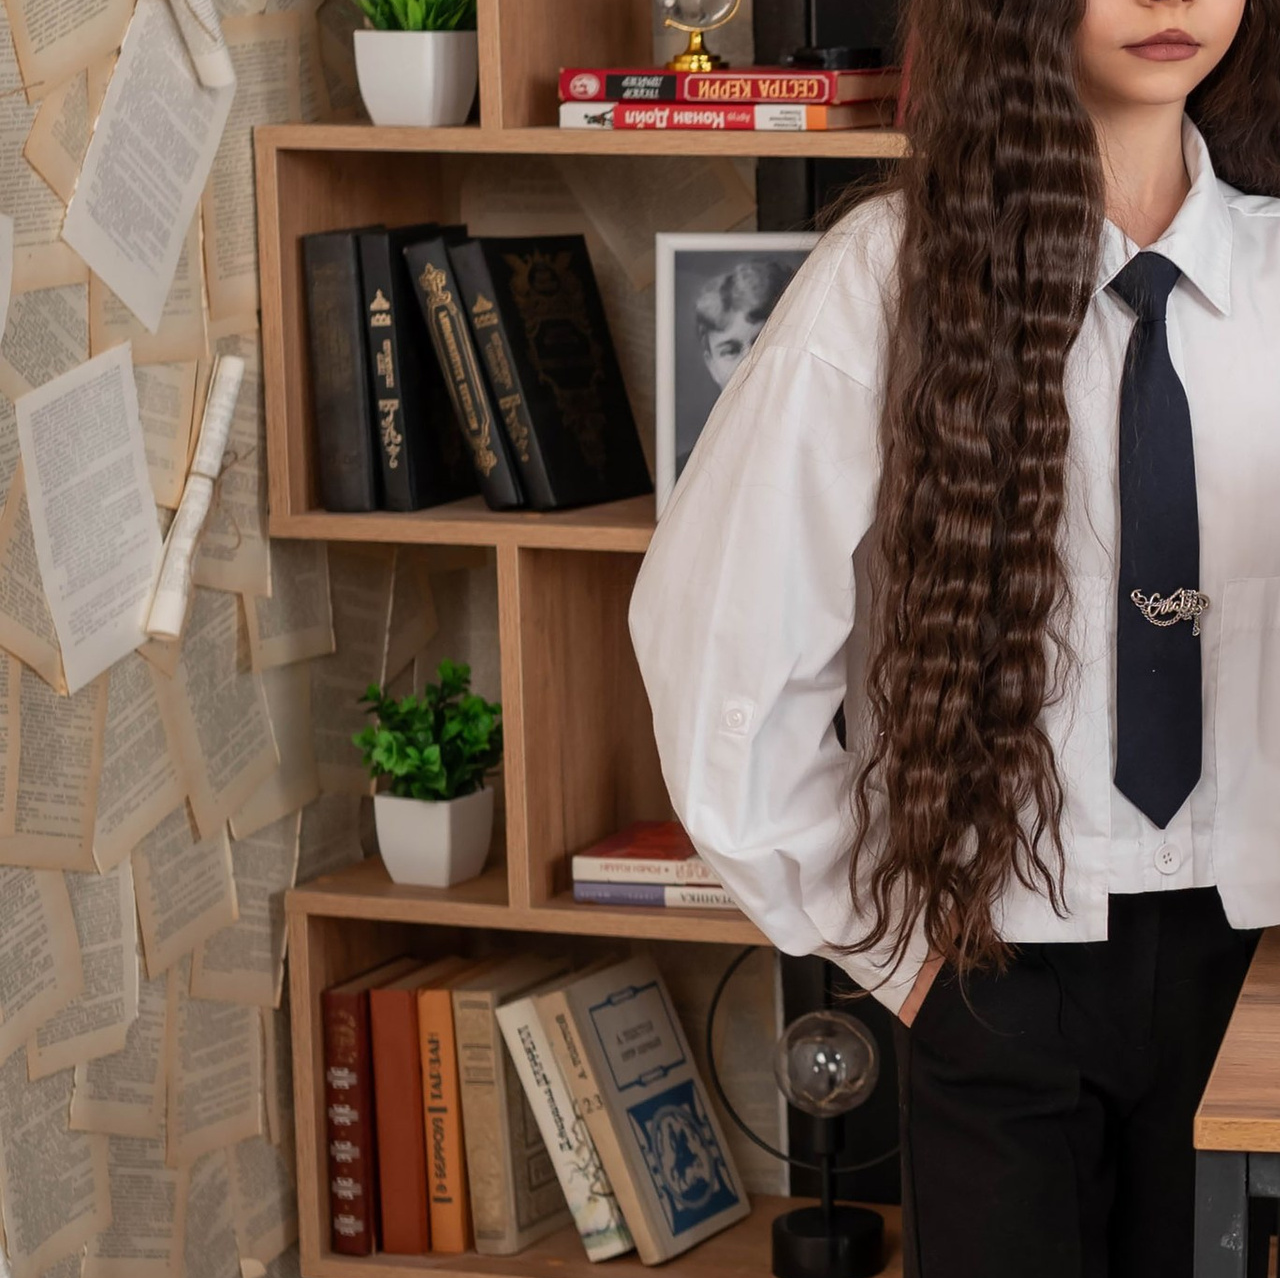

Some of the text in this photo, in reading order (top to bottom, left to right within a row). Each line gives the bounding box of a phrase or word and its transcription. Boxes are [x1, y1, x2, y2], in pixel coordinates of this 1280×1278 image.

[698, 78, 818, 99] СЕСТРА КЕРРИ
[624, 107, 671, 128] Дойл
[673, 108, 725, 129] Конан
